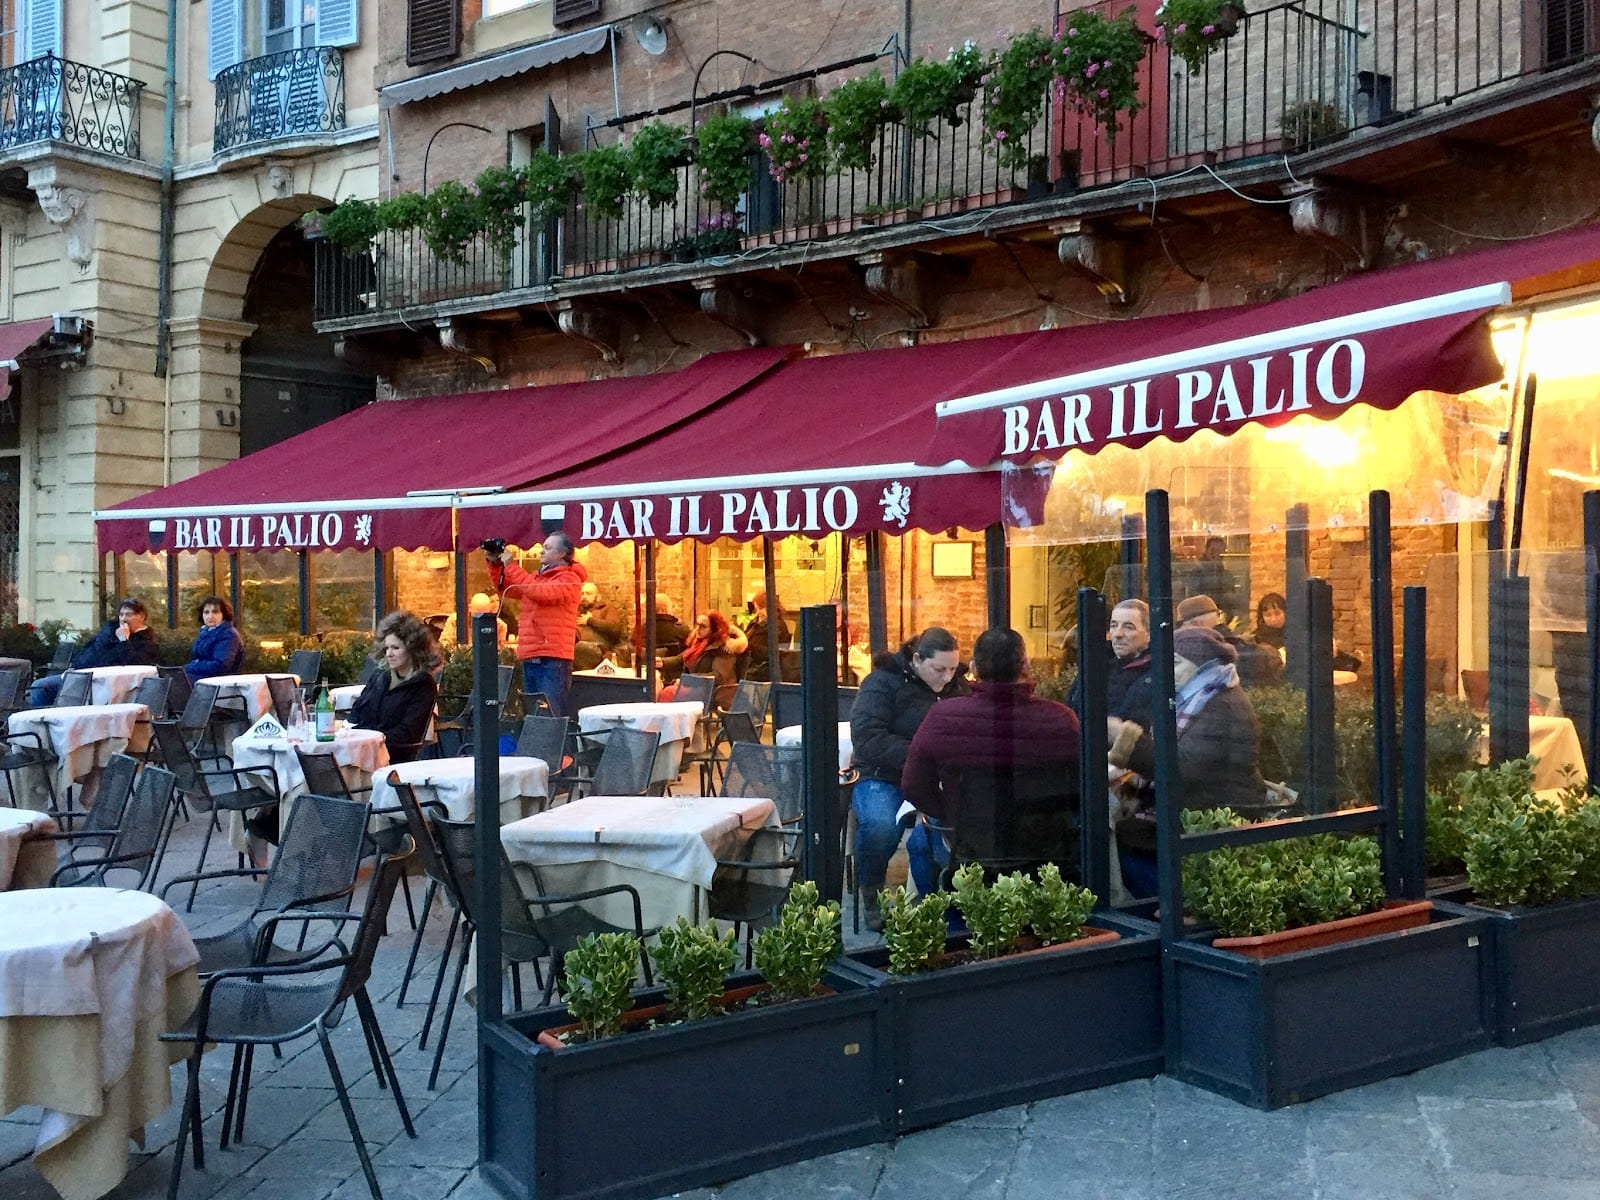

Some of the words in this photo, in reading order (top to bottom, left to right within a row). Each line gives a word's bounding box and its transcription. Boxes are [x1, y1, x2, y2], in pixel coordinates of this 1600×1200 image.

[1000, 393, 1094, 456] BAR
[1106, 378, 1163, 440] IL
[1174, 338, 1366, 430] PALIO
[174, 516, 223, 549] BAR
[227, 516, 256, 548] IL
[261, 512, 343, 548] PALIO
[579, 498, 655, 540] BAR
[666, 495, 711, 536] IL
[719, 485, 859, 534] PALIO
